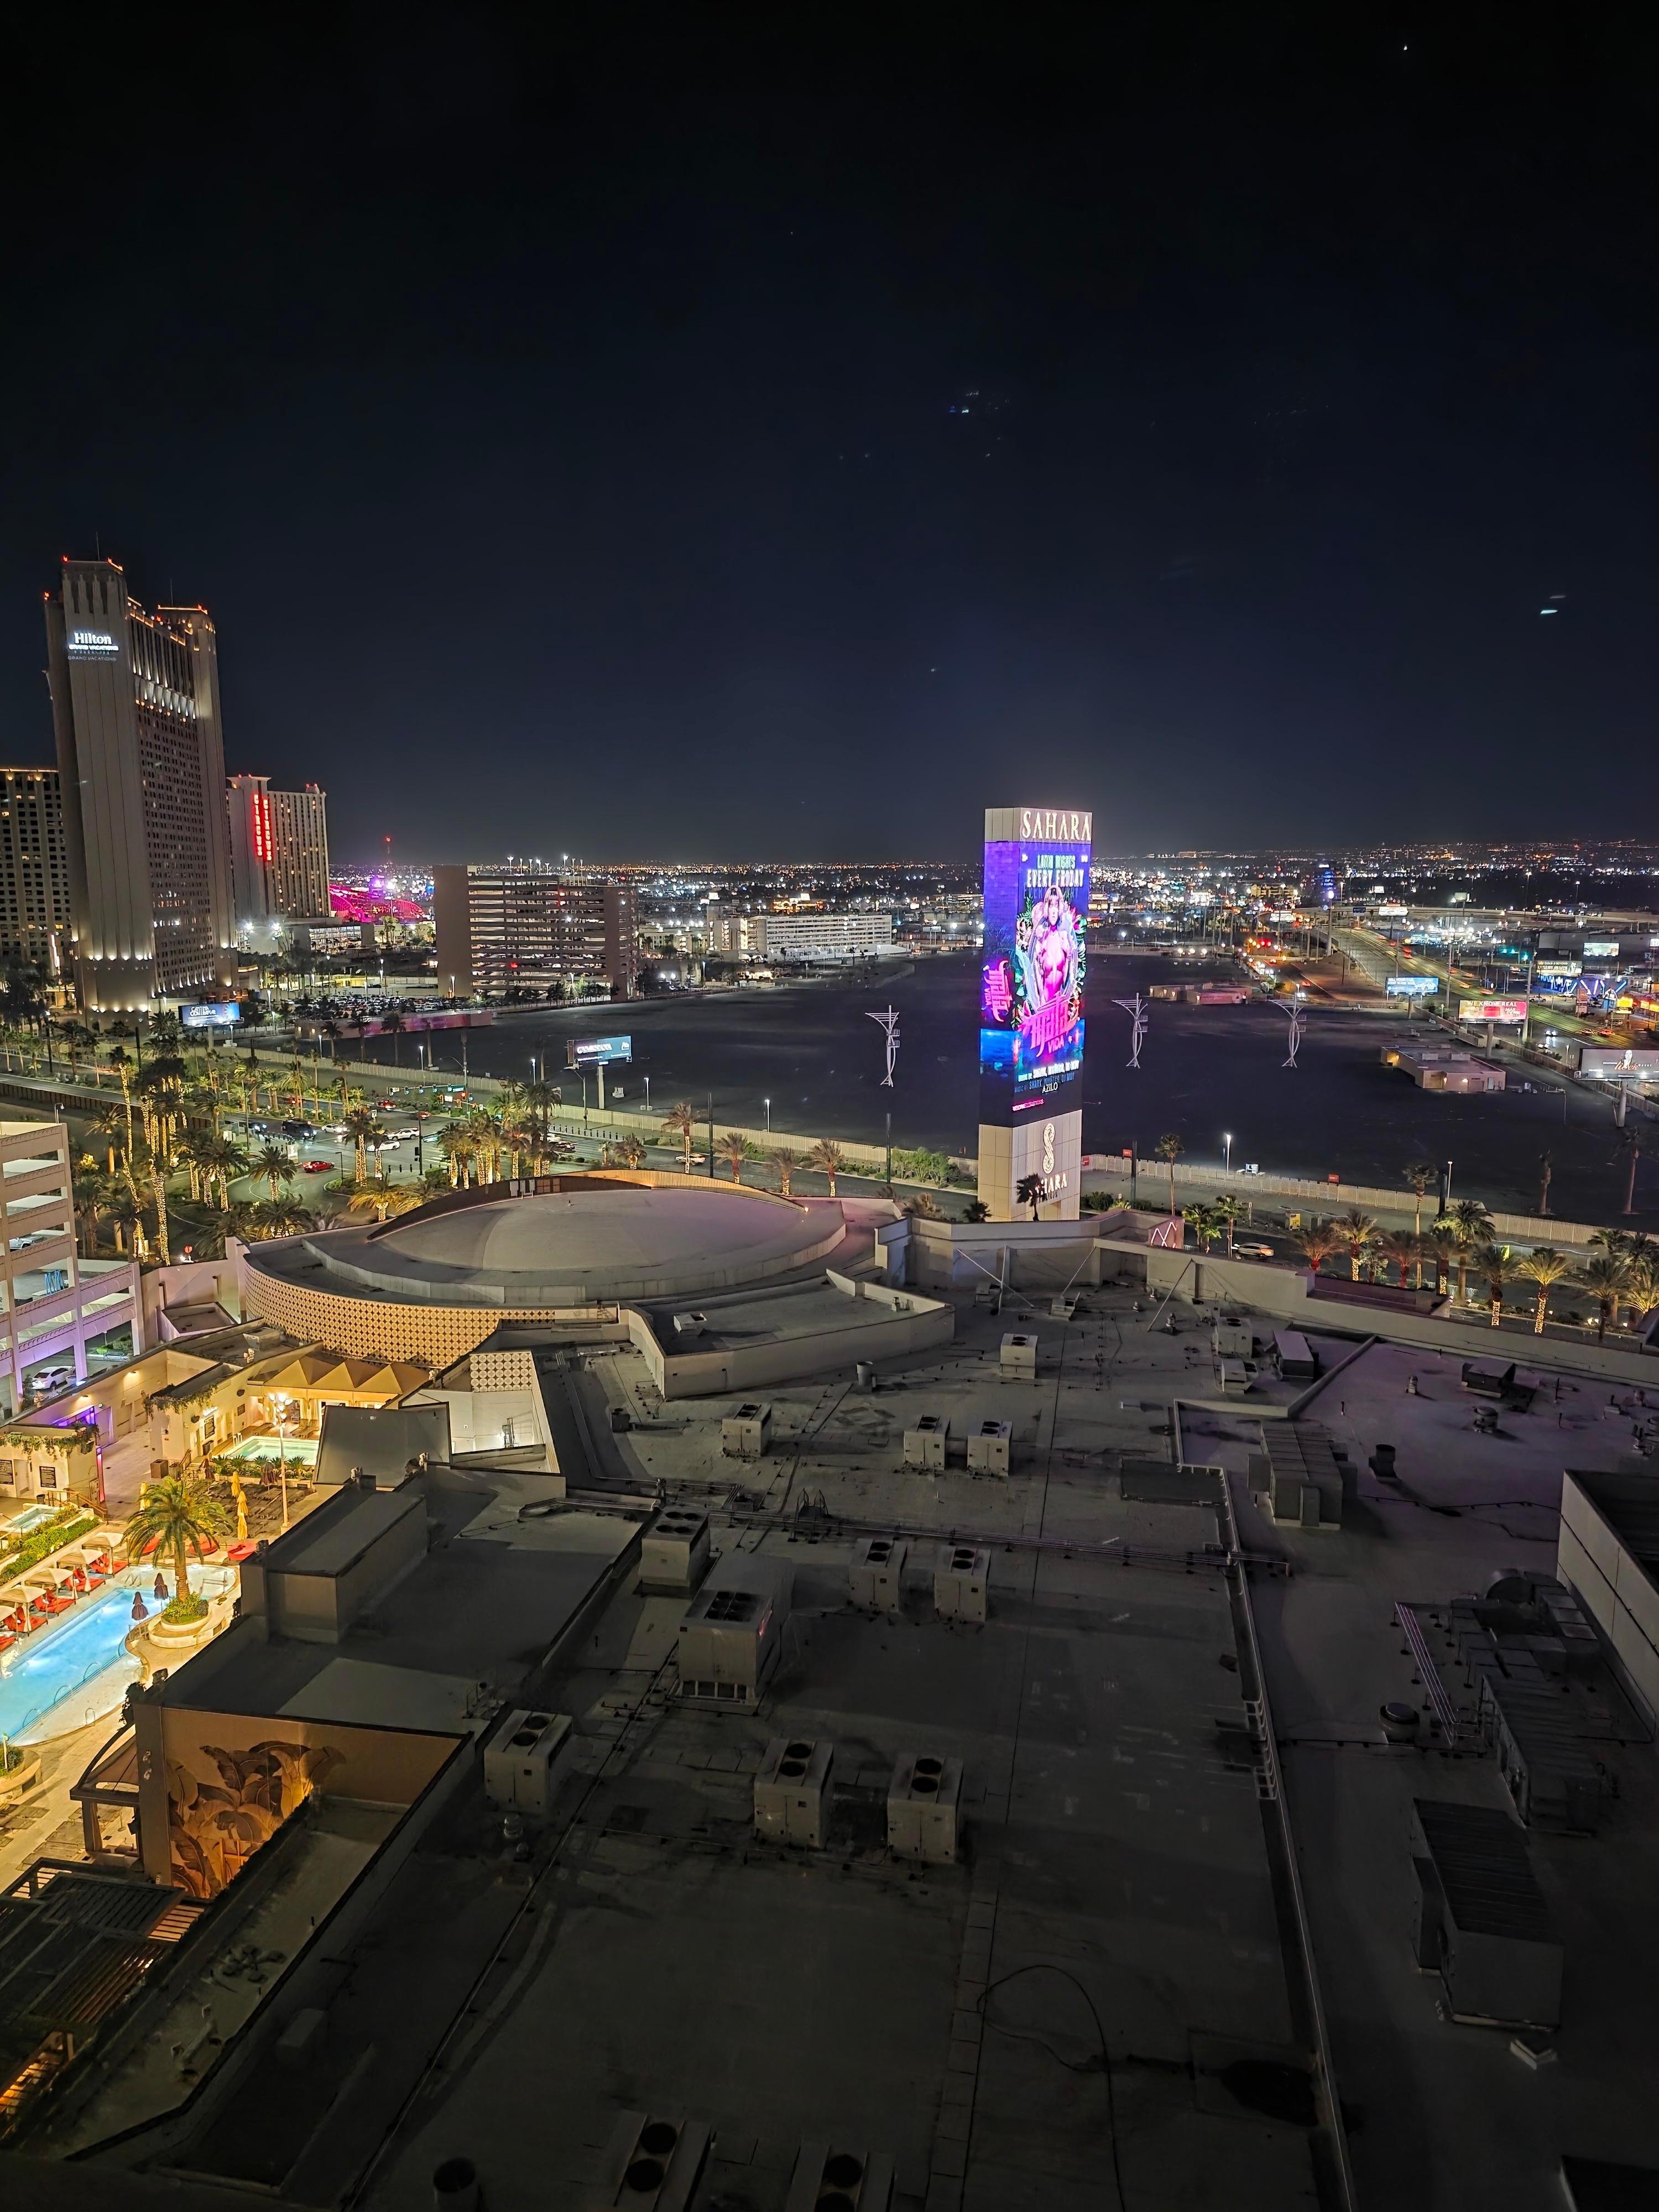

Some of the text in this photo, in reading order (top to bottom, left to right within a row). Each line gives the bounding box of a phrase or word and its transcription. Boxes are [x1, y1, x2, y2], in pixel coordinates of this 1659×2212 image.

[74, 633, 112, 644] Hilton
[1022, 810, 1091, 841] SAHARA
[1027, 869, 1084, 888] EVERY FRIDAY
[1047, 1035, 1065, 1053] VIDA
